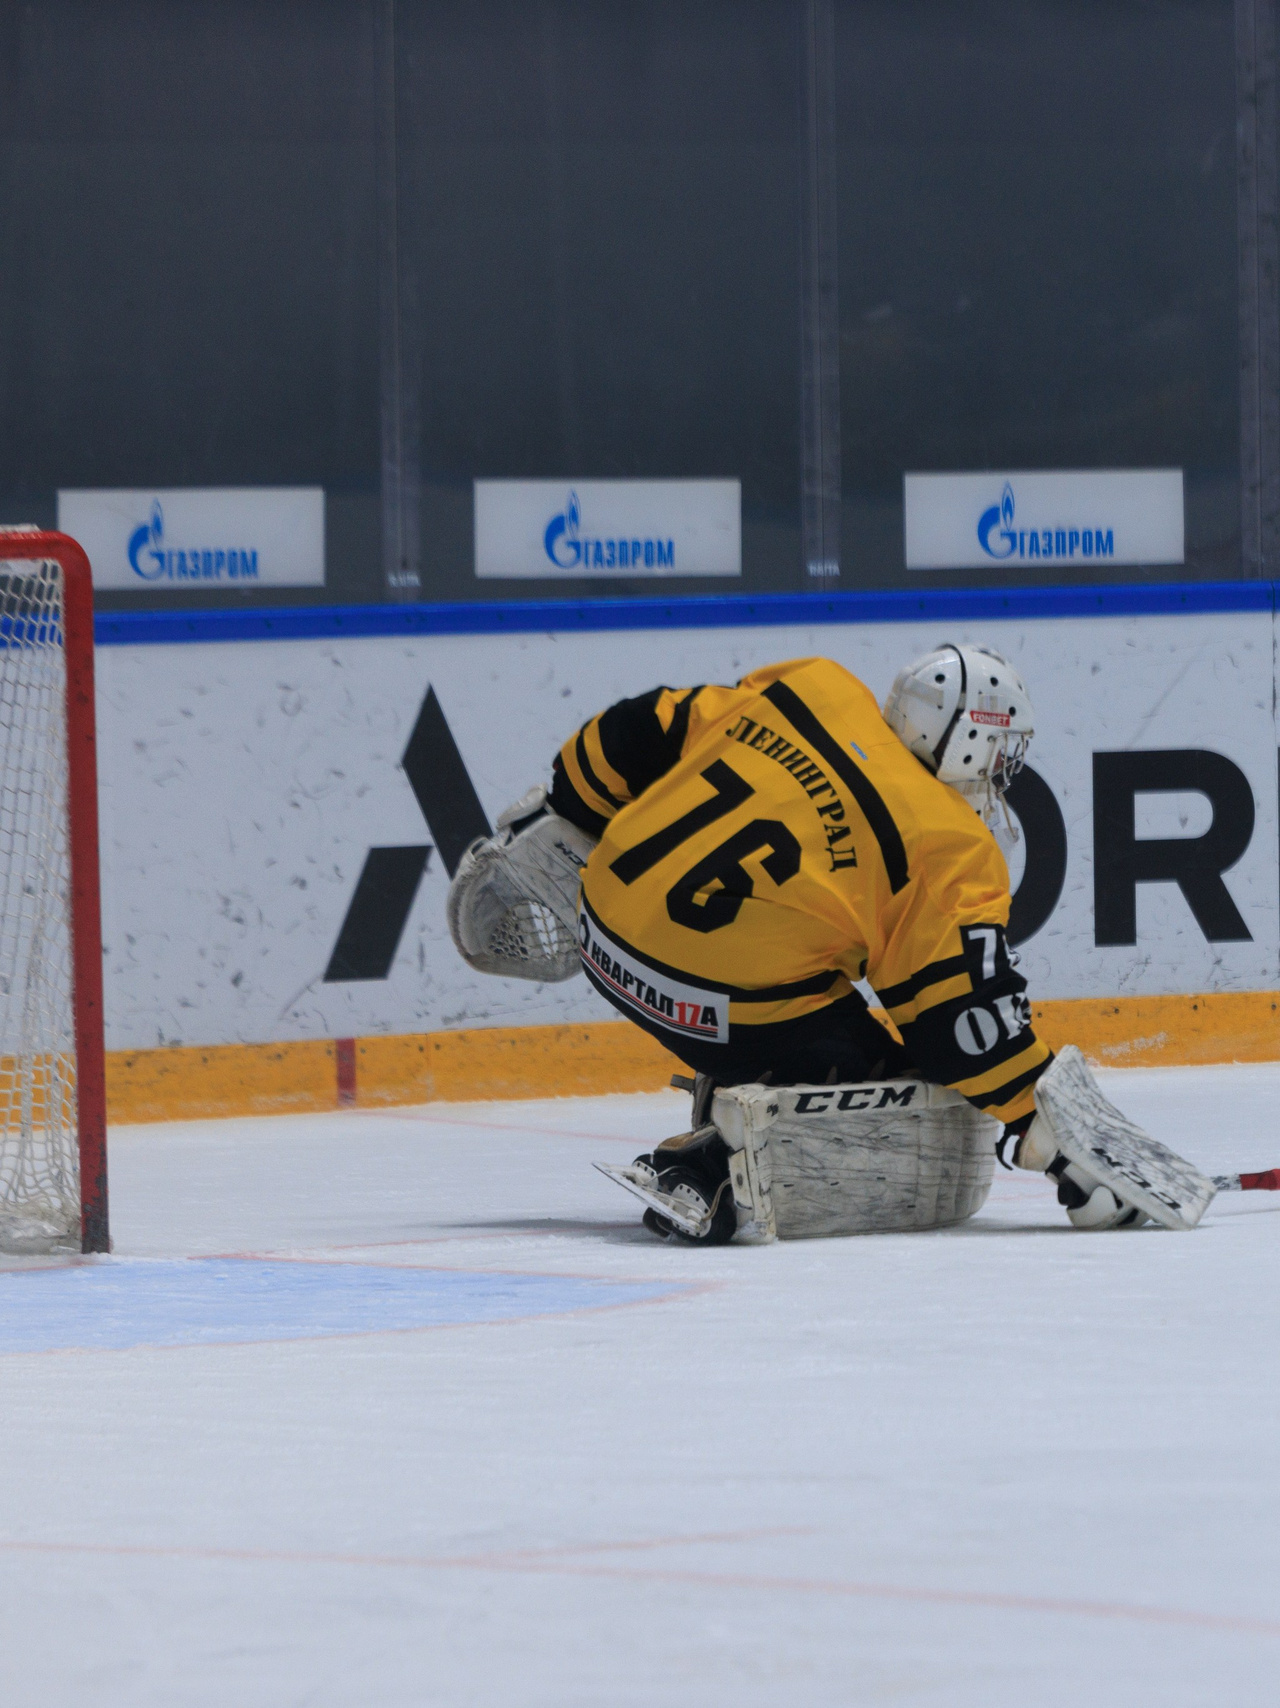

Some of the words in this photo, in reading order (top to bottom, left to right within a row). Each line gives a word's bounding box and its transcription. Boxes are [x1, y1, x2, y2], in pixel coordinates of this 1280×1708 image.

[584, 537, 676, 569] ГАЗПРОМ
[1016, 527, 1114, 559] ГАЗПРОМ
[167, 548, 259, 580] ГАЗПРОМ
[973, 713, 1008, 726] FONBET
[725, 715, 858, 873] ЛЕНИНГРАД
[609, 758, 802, 934] 76
[794, 1085, 917, 1114] CCM
